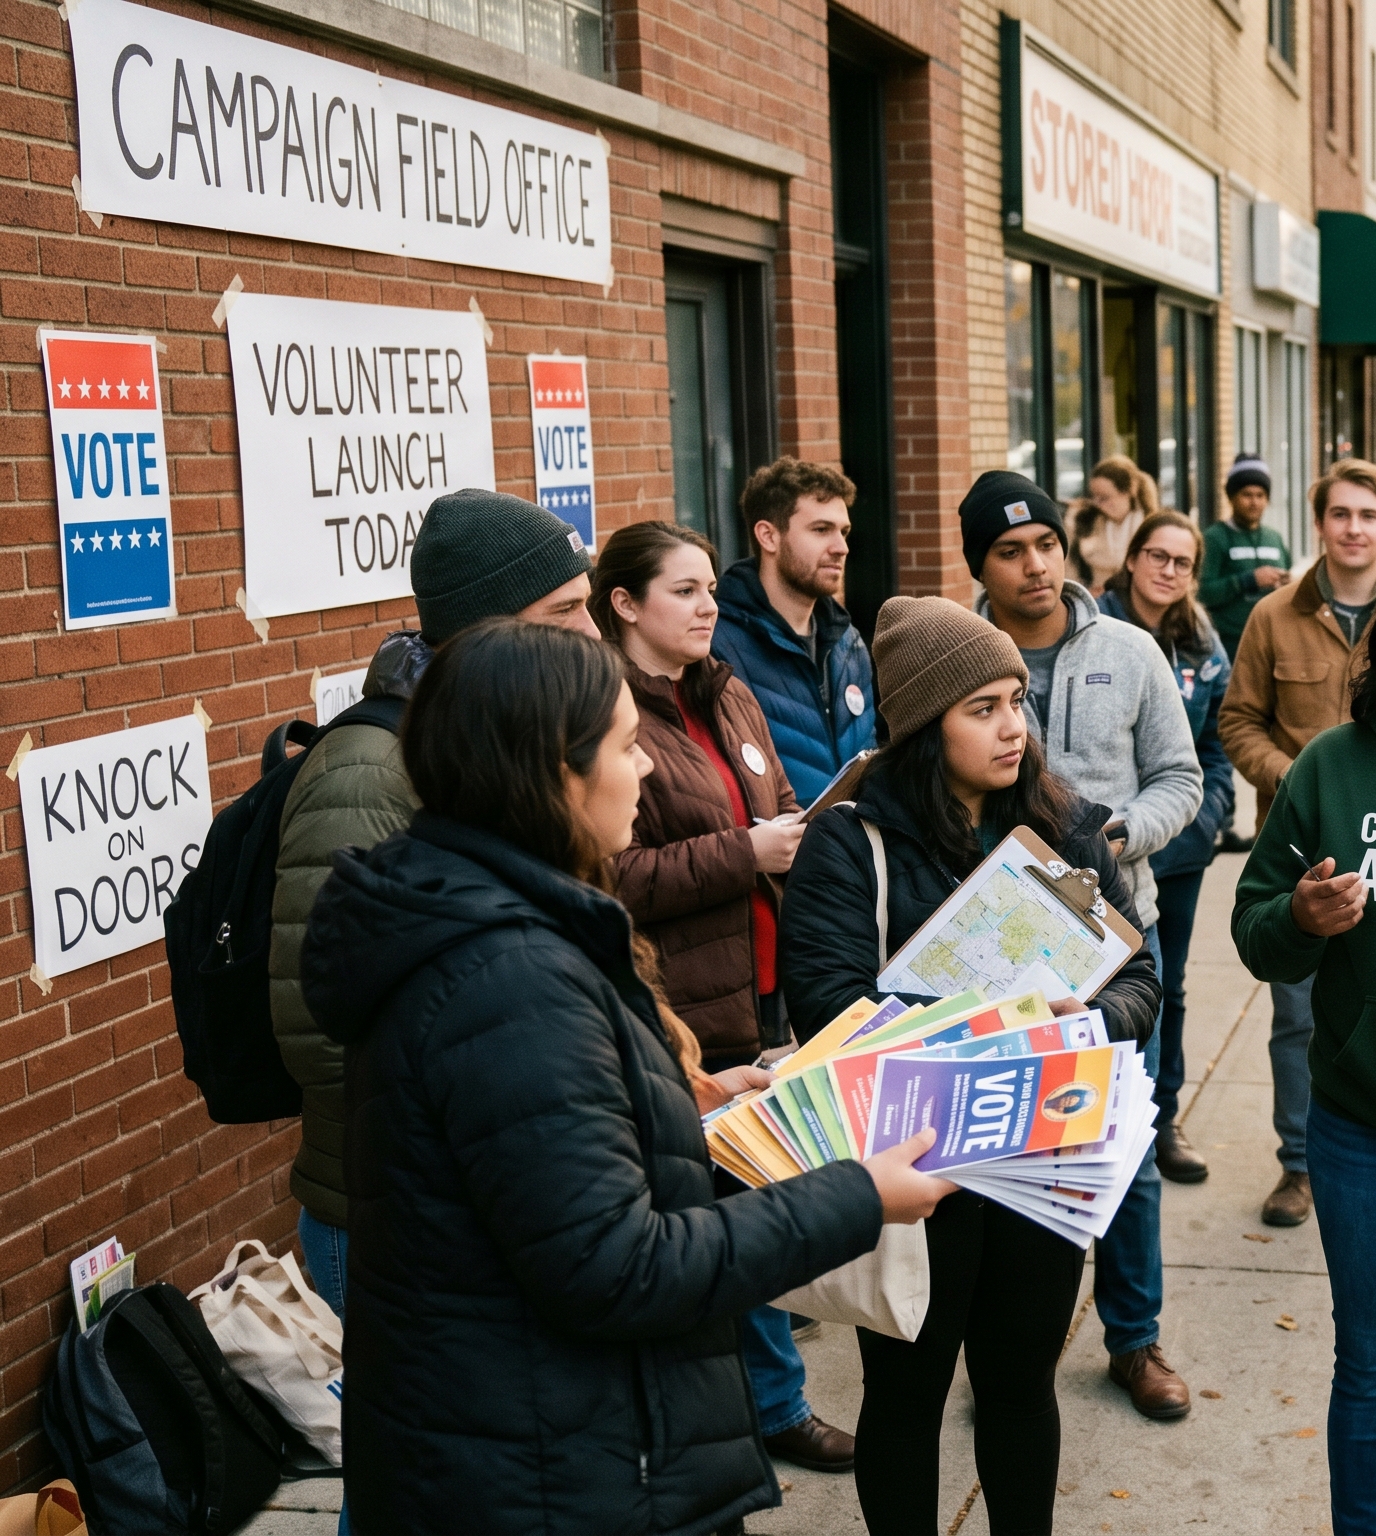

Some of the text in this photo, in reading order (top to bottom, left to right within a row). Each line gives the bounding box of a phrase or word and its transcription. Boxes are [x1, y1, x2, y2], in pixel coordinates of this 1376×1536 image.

[111, 43, 595, 248] CAMPAIGN FIELD OFFICE
[252, 342, 469, 416] VOLUNTEER
[61, 430, 160, 500] VOTE
[308, 431, 448, 498] LAUNCH
[537, 424, 588, 471] VOTE
[324, 509, 425, 577] TODA
[41, 740, 198, 843] KNOCK
[107, 825, 145, 861] ON
[961, 1069, 1018, 1155] VOTE
